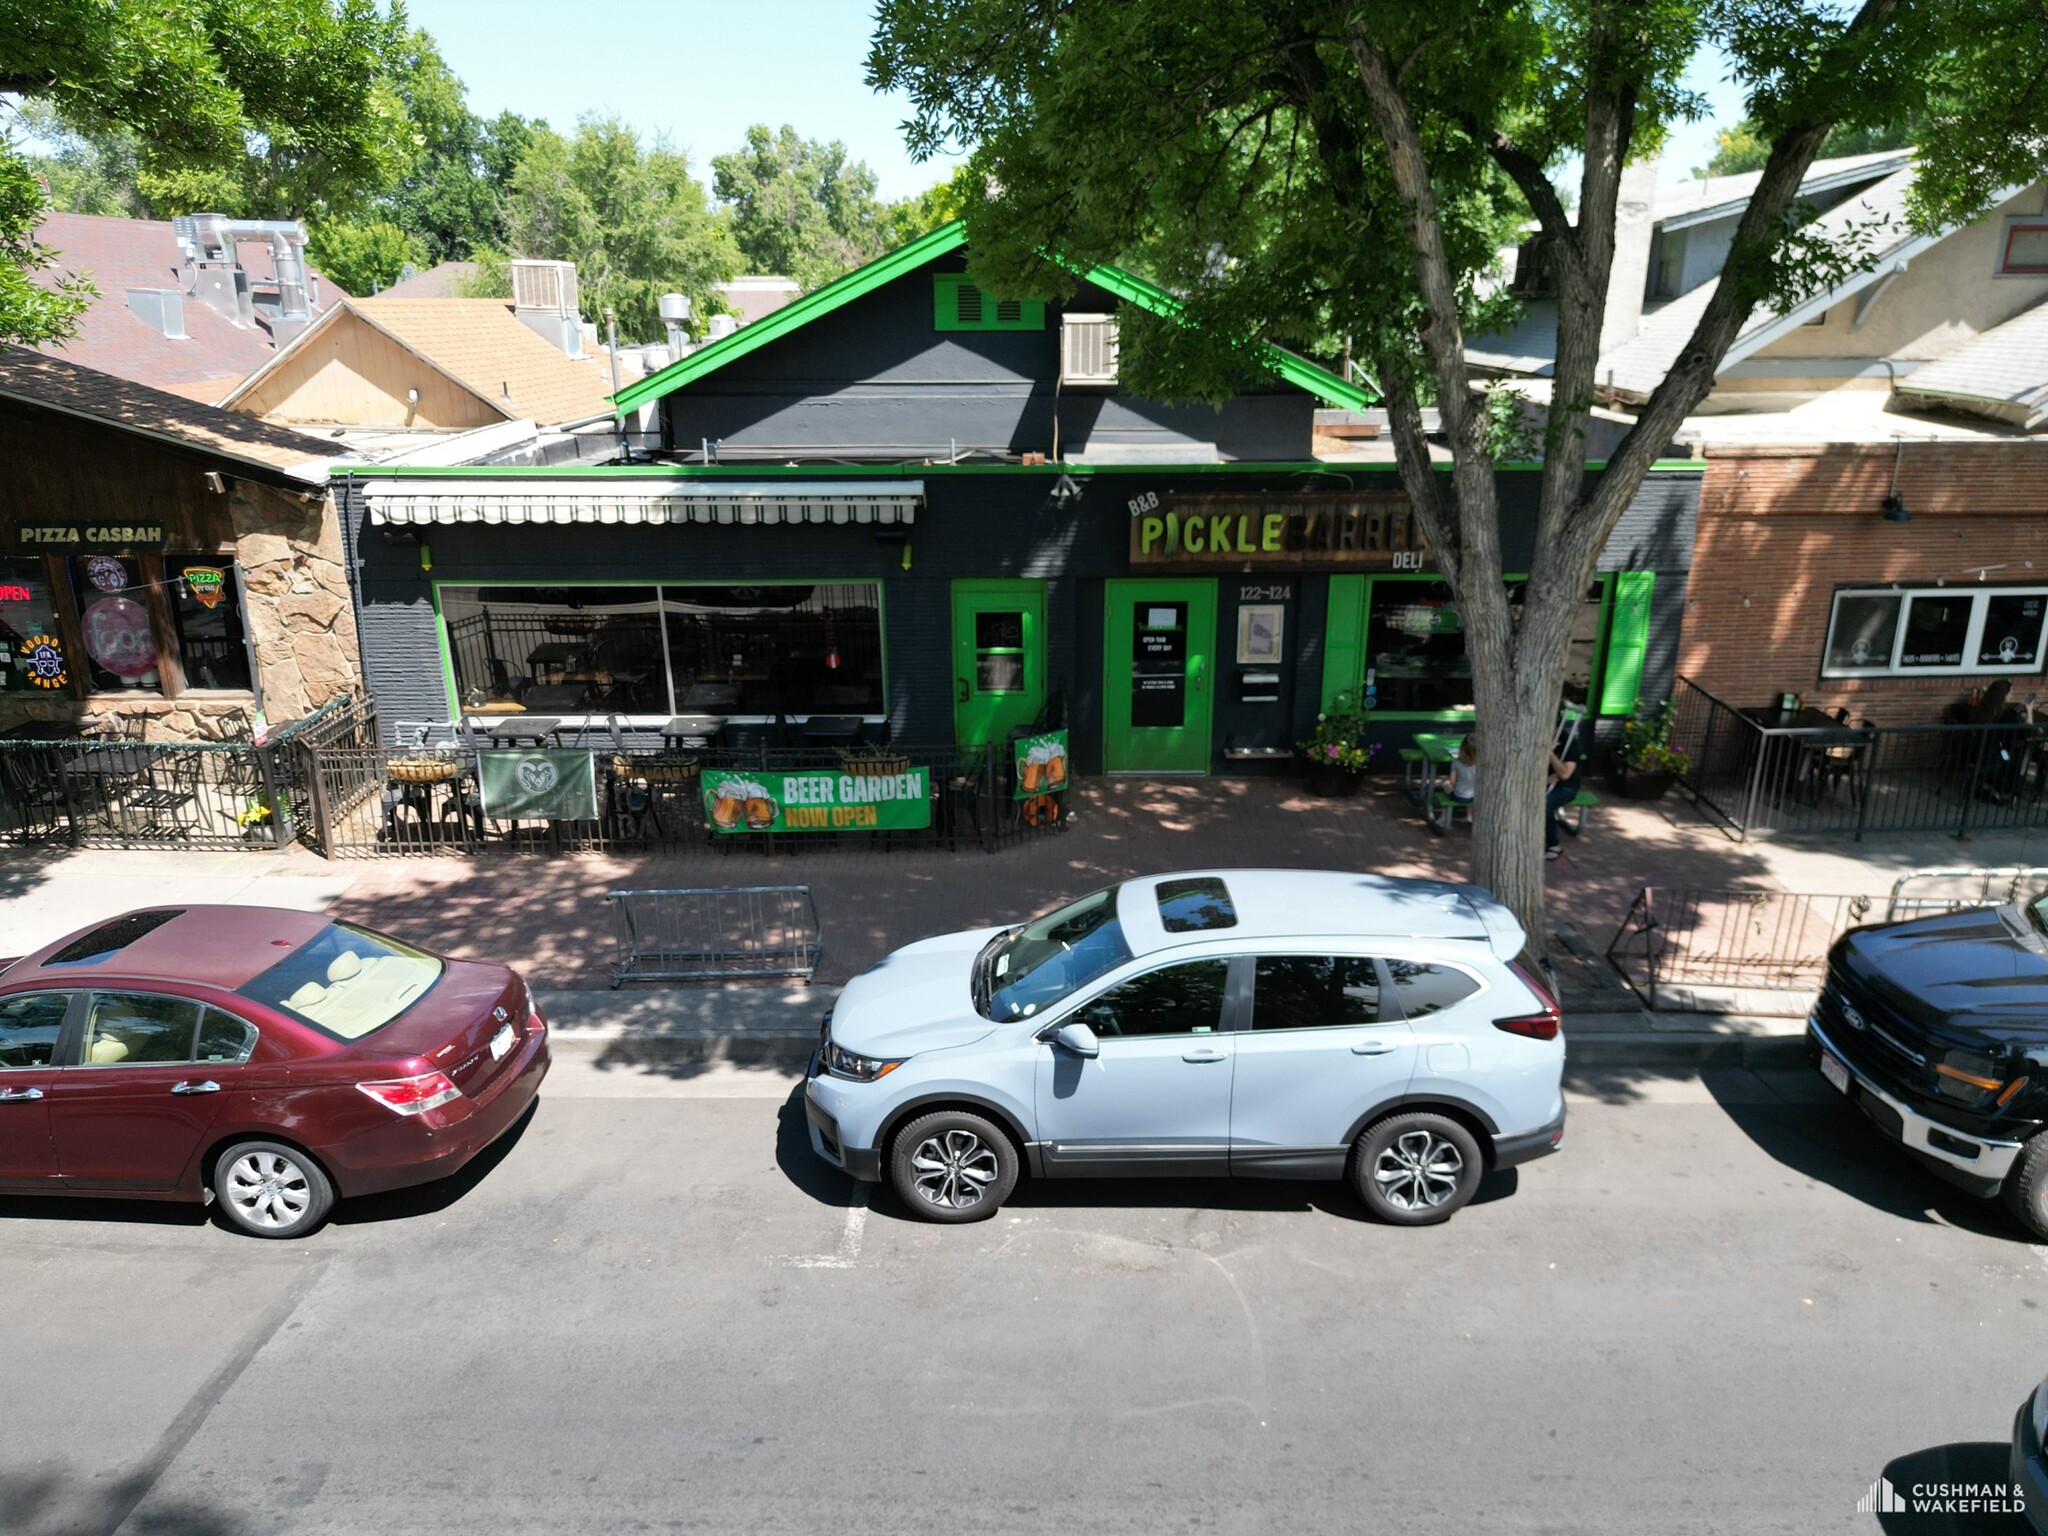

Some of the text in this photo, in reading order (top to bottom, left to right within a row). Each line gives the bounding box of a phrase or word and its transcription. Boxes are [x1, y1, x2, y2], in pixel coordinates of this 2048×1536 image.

[1128, 491, 1160, 517] B&B
[21, 526, 162, 543] PIZZA CASBAH
[1141, 511, 1429, 557] PICKLE BARREL
[1392, 552, 1424, 569] DELI
[189, 573, 222, 583] PIZZA
[1239, 586, 1291, 600] 122-124
[784, 773, 922, 804] BEER GARDEN
[785, 805, 877, 829] NOW OPEN
